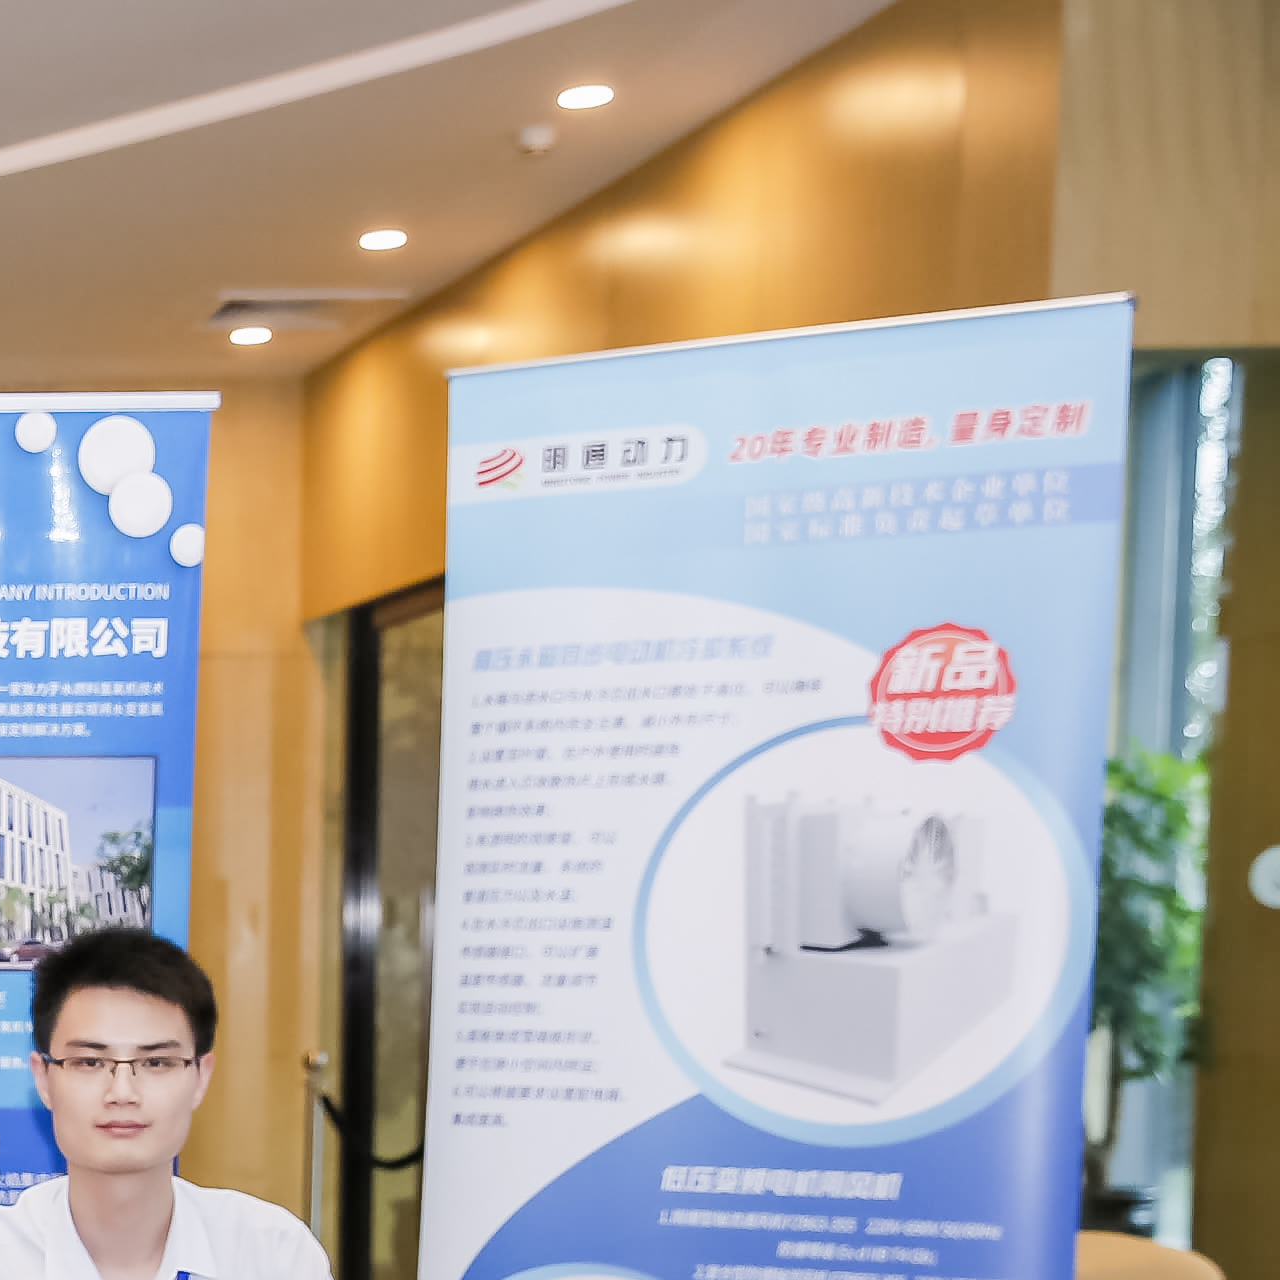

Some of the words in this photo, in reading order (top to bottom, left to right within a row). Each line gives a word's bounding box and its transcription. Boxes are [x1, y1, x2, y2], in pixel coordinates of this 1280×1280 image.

[35, 583, 171, 602] INTRODUCTION
[887, 641, 999, 693] 新品
[874, 696, 1016, 734] 特别推荐
